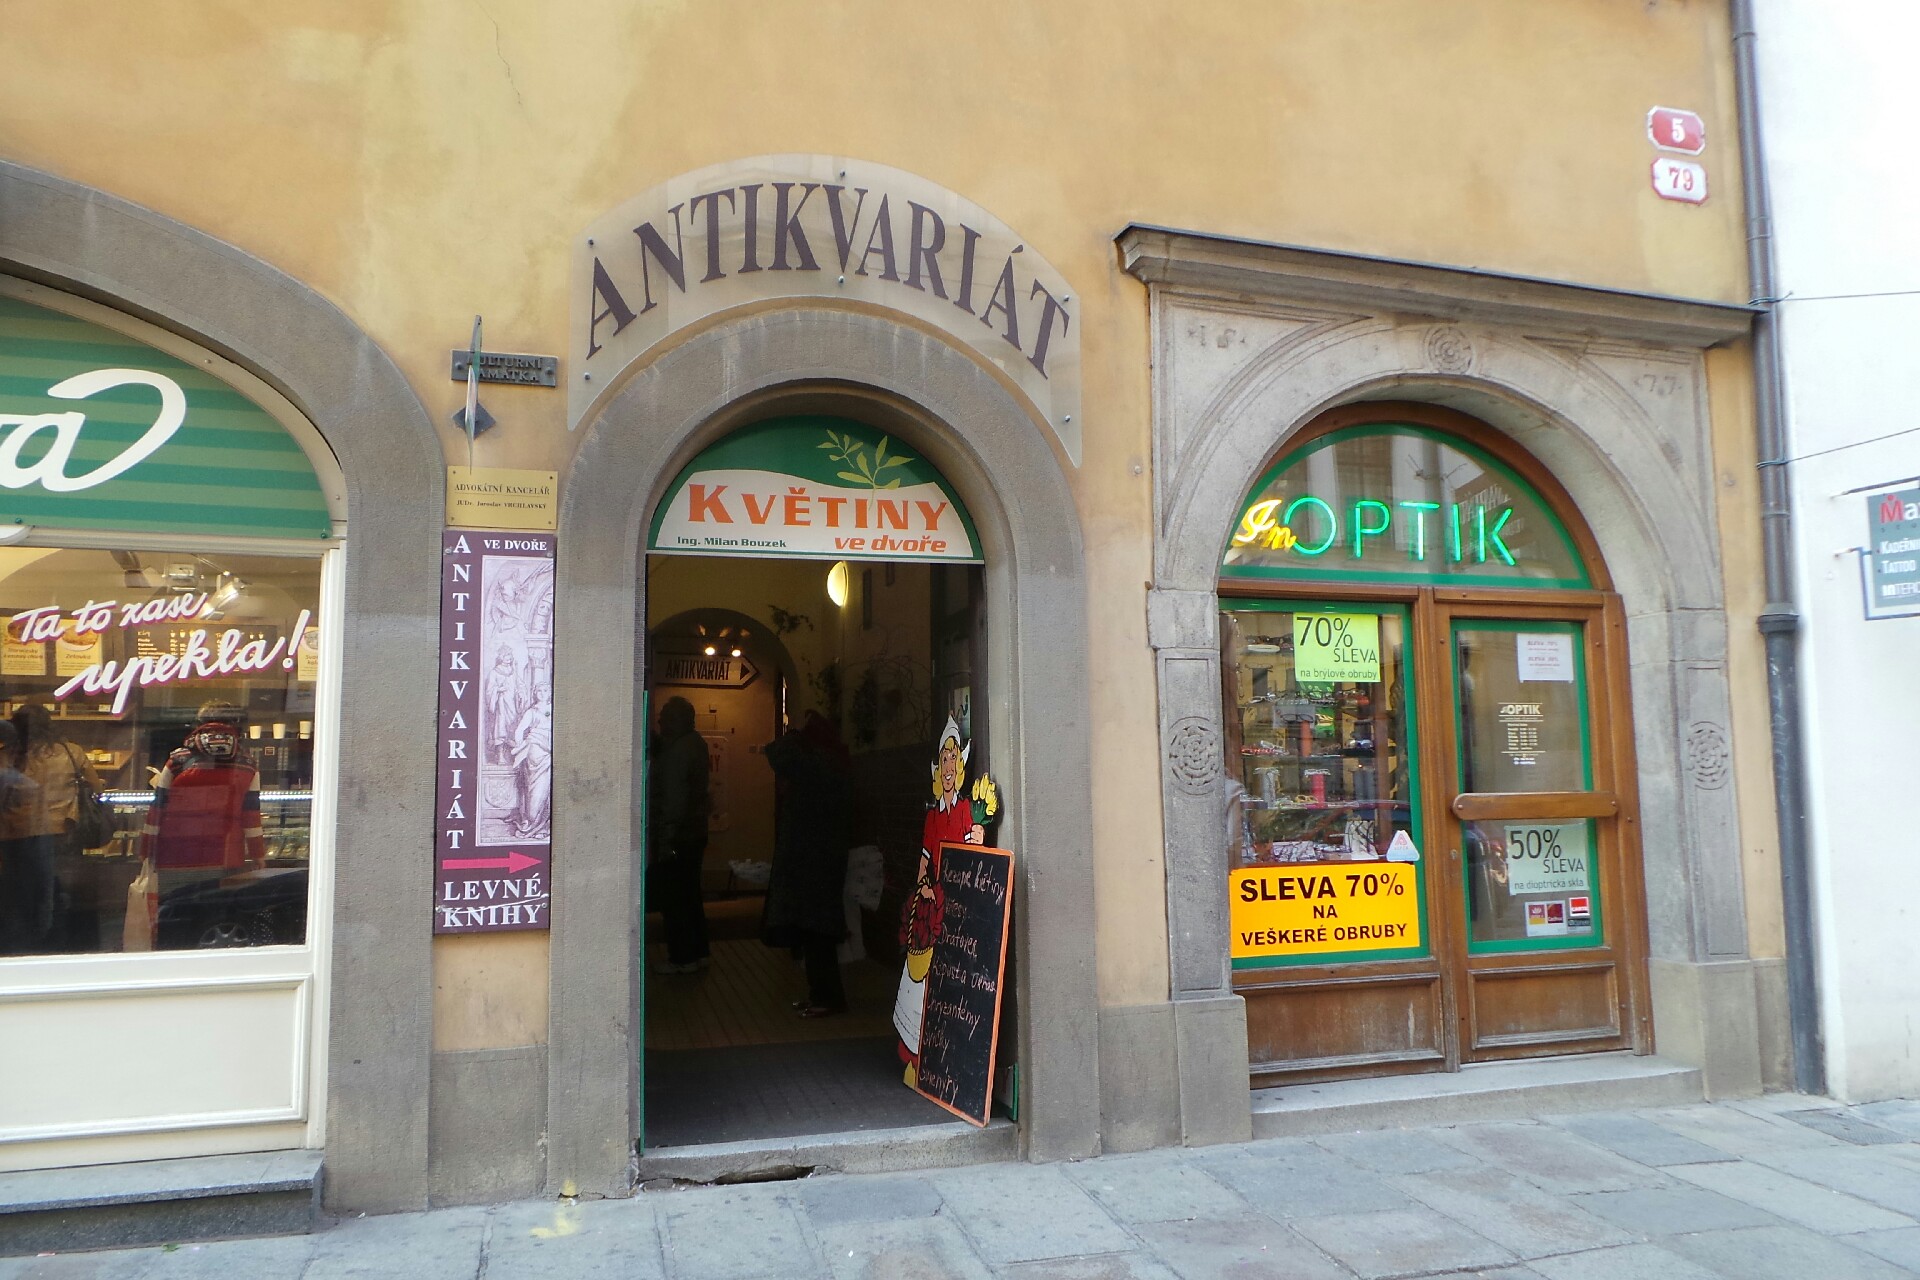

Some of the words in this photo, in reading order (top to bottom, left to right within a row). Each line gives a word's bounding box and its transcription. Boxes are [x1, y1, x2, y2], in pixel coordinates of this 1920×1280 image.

[1671, 118, 1684, 143] 5
[1669, 166, 1693, 191] 79
[586, 182, 1070, 380] ANTIKVARIÁT
[688, 484, 947, 532] KVĚTINY
[1880, 495, 1920, 524] Ma
[677, 536, 700, 547] Ing.
[704, 536, 738, 547] Milan
[741, 538, 787, 548] Bouzek
[1284, 497, 1516, 566] OPTIK
[483, 539, 500, 550] VE
[504, 538, 548, 551] DVOŘE
[834, 537, 865, 550] ve
[871, 535, 947, 553] dvoře
[13, 605, 65, 643] Ta
[71, 600, 117, 633] to
[1296, 616, 1353, 647] 70%
[1333, 648, 1378, 664] SLEVA
[665, 657, 731, 681] ANTIKVARIÁT
[1314, 668, 1345, 680] brýlové
[1348, 669, 1377, 680] obruby
[446, 534, 472, 849] ANTIKVARIÁT
[1507, 704, 1541, 715] OPTIK
[1510, 829, 1562, 859] 50%
[1543, 858, 1585, 873] SLEVA
[443, 873, 541, 900] LEVNÉ
[1240, 876, 1336, 902] SLEVA
[1346, 873, 1404, 896] 70%
[1515, 882, 1524, 890] na
[443, 904, 541, 927] KNIHY
[1313, 905, 1338, 919] NA
[1241, 924, 1327, 946] VEŠKERÉ
[1334, 923, 1407, 940] OBRUBY
